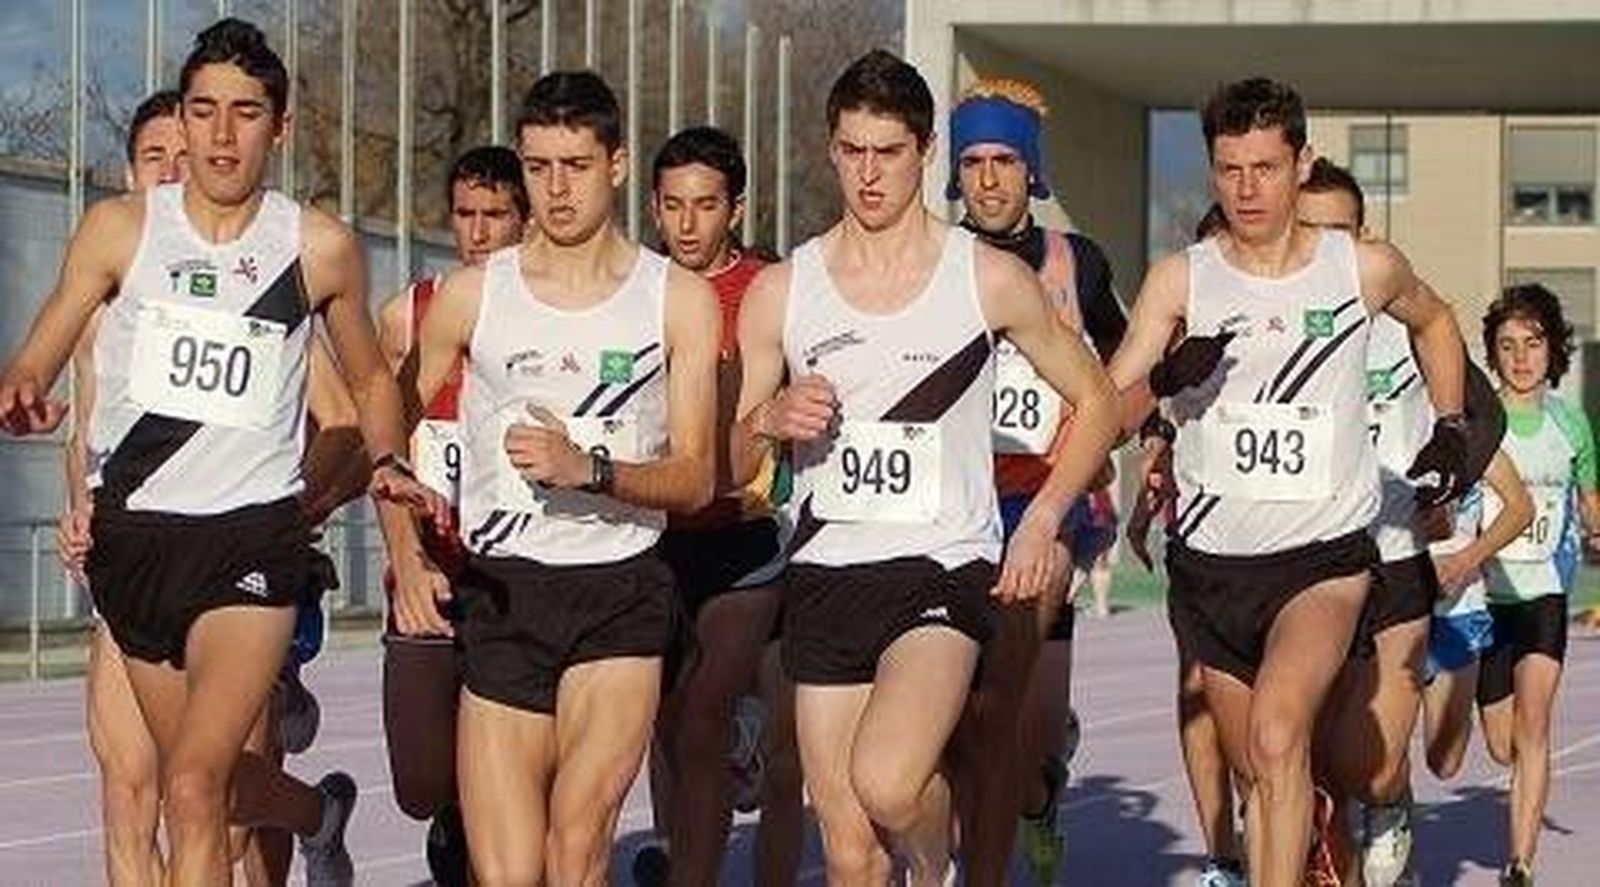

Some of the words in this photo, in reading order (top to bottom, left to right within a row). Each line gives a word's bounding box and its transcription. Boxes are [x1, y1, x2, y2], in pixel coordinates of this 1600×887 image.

[169, 336, 251, 397] 950
[842, 447, 911, 495] 949
[1235, 428, 1305, 475] 943
